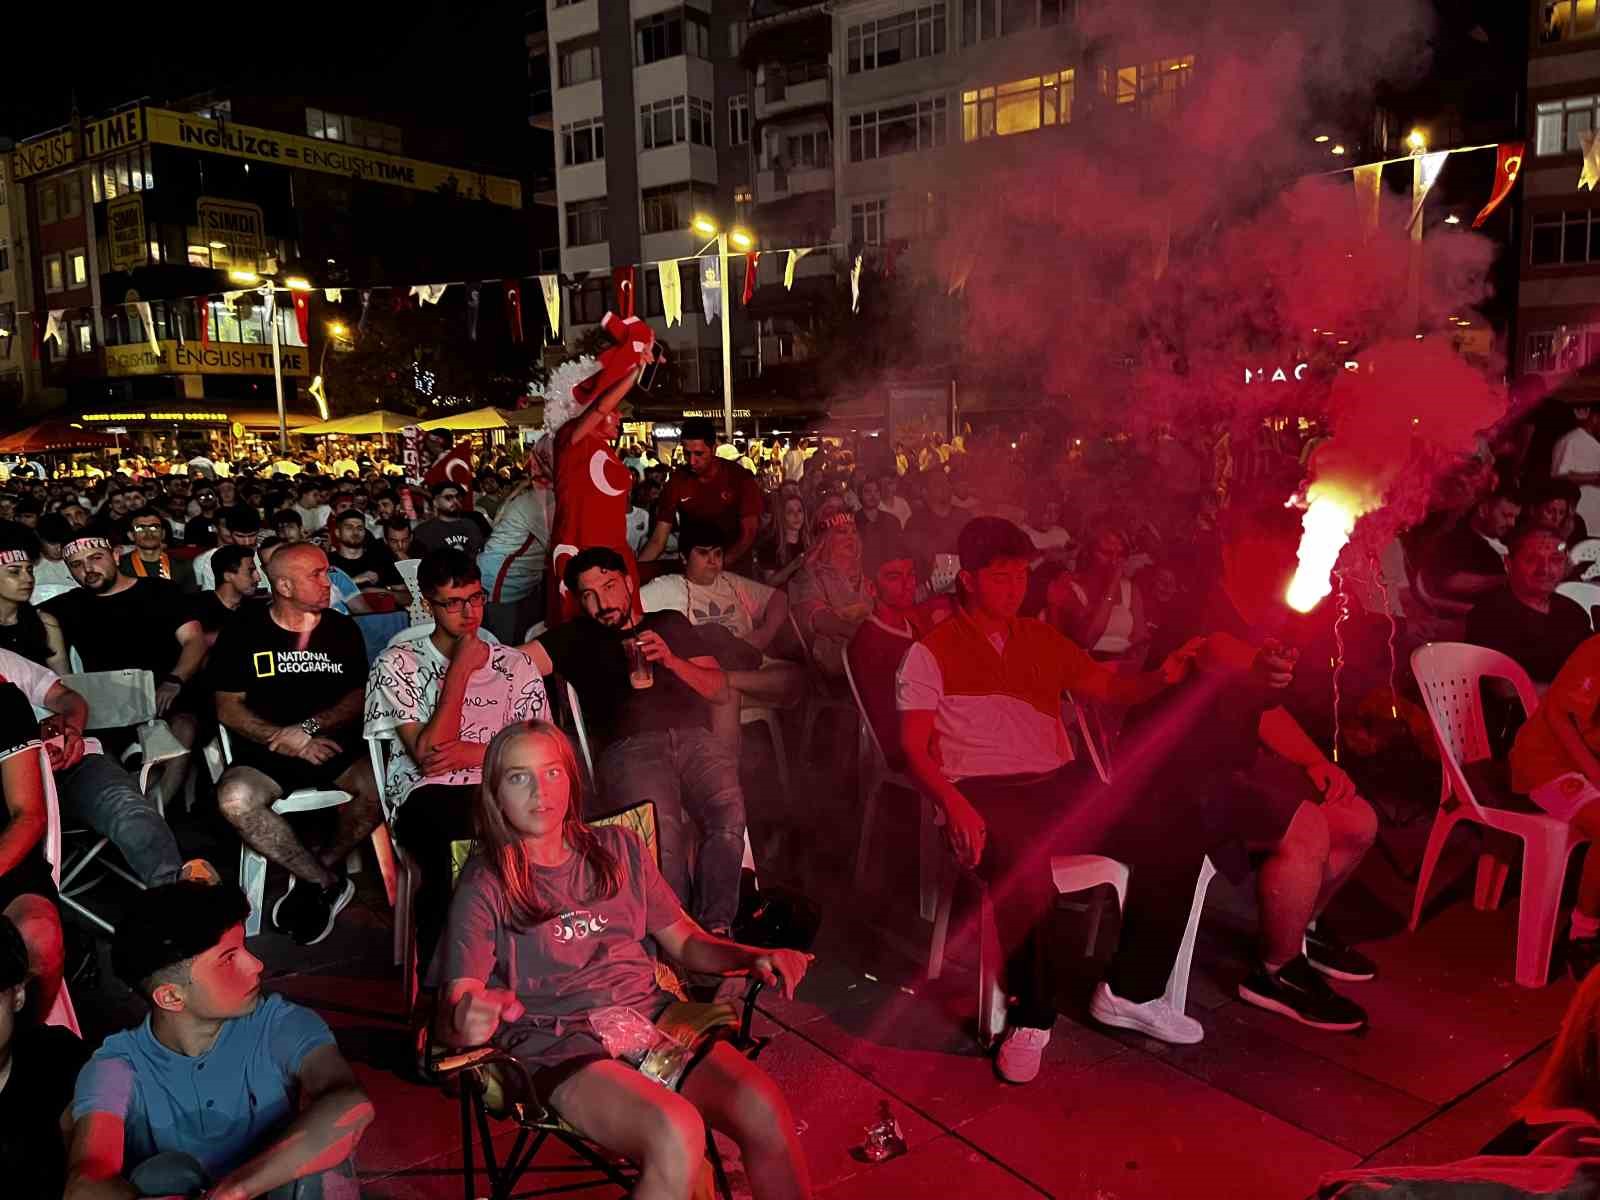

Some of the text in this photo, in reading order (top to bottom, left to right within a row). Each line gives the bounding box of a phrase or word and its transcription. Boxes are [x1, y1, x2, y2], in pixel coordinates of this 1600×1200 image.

[12, 111, 137, 177] ENGLISH TIME
[304, 147, 377, 178] ENGLISH
[377, 162, 416, 183] TIME
[176, 349, 256, 369] ENGLISH
[277, 650, 331, 662] NATIONAL
[277, 661, 344, 674] GEOGRAPHIC
